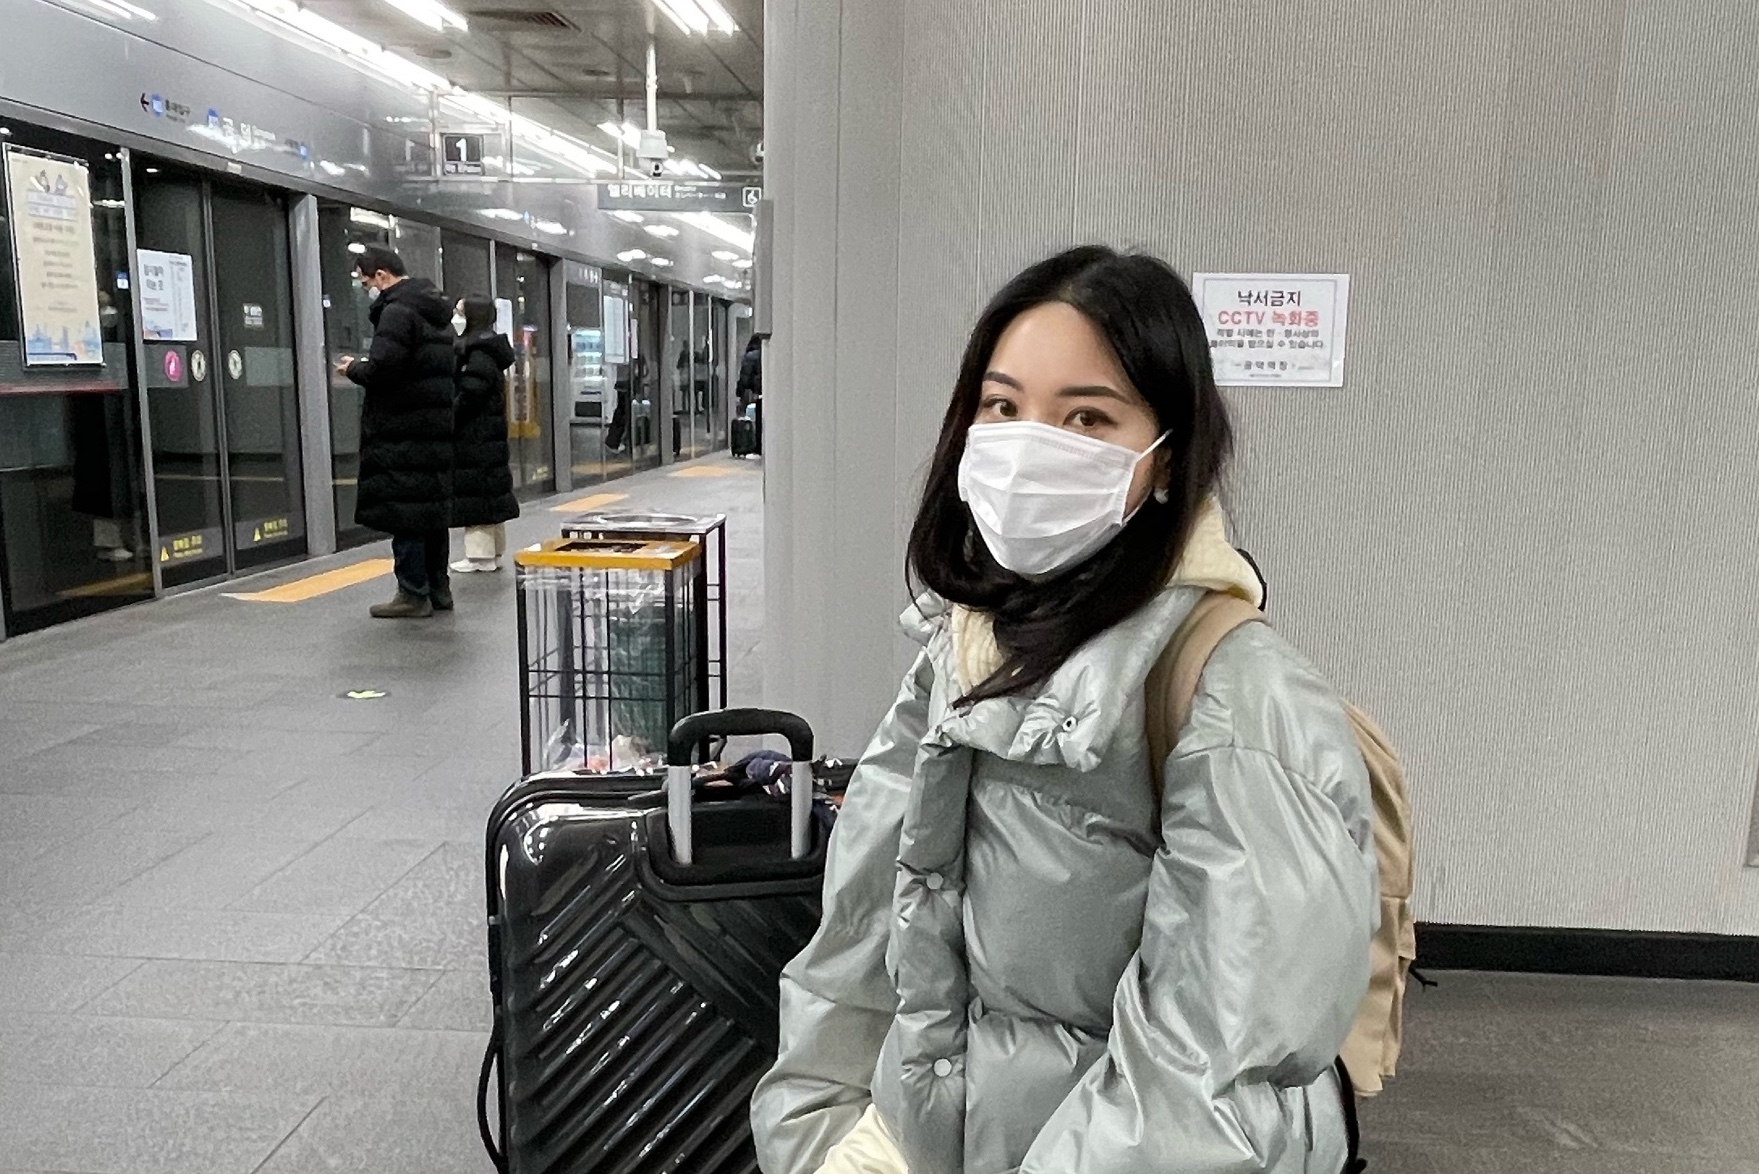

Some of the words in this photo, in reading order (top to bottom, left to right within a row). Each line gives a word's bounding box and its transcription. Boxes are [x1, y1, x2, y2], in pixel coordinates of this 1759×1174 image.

[456, 138, 467, 162] 1
[1237, 290, 1302, 307] 낙서금지
[1218, 310, 1266, 325] CCTV
[1271, 310, 1320, 327] 녹화중
